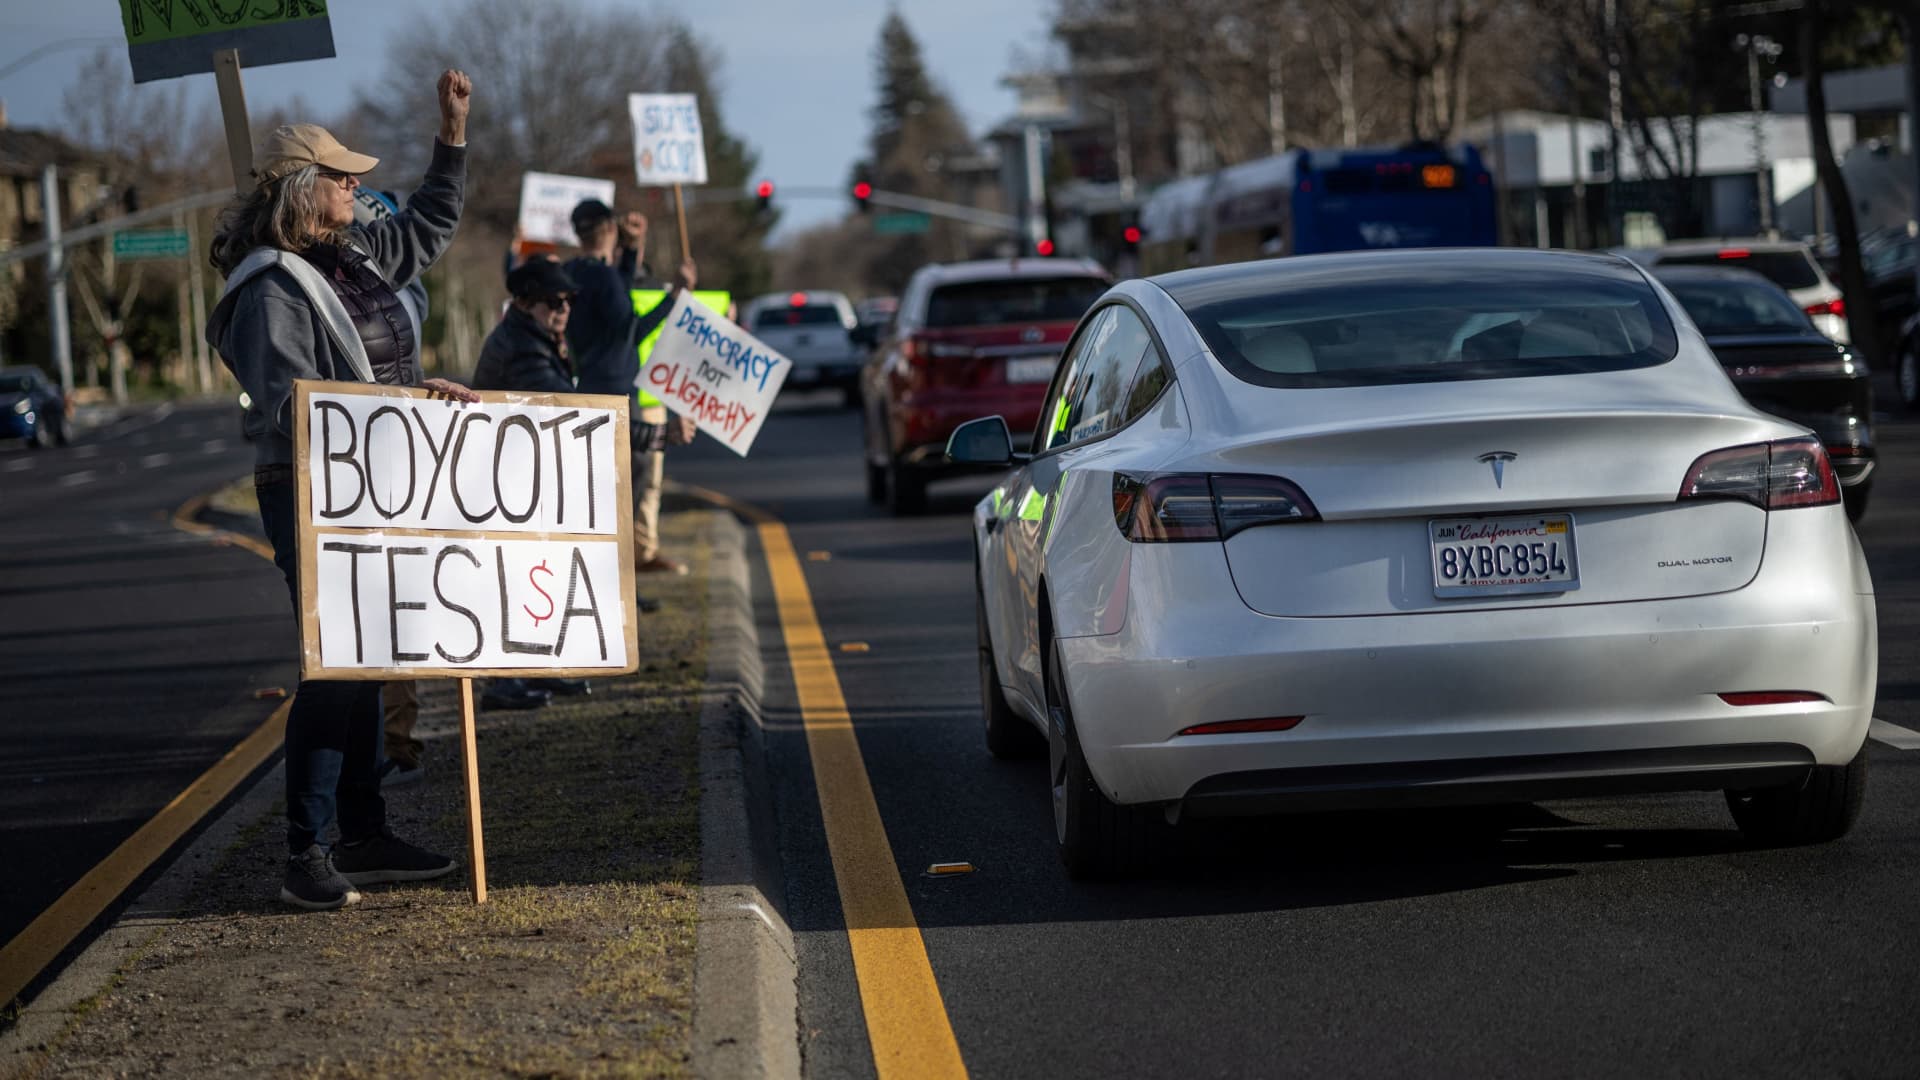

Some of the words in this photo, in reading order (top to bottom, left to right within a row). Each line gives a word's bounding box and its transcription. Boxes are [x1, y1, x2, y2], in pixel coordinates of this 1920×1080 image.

[676, 306, 779, 392] DEMOCRACY
[313, 400, 611, 529] BOYCOTT
[1438, 527, 1455, 538] JUN
[1459, 523, 1547, 544] California
[1442, 541, 1567, 579] 8XBC854
[1657, 560, 1690, 568] DUAL
[1692, 556, 1733, 565] MOTOR
